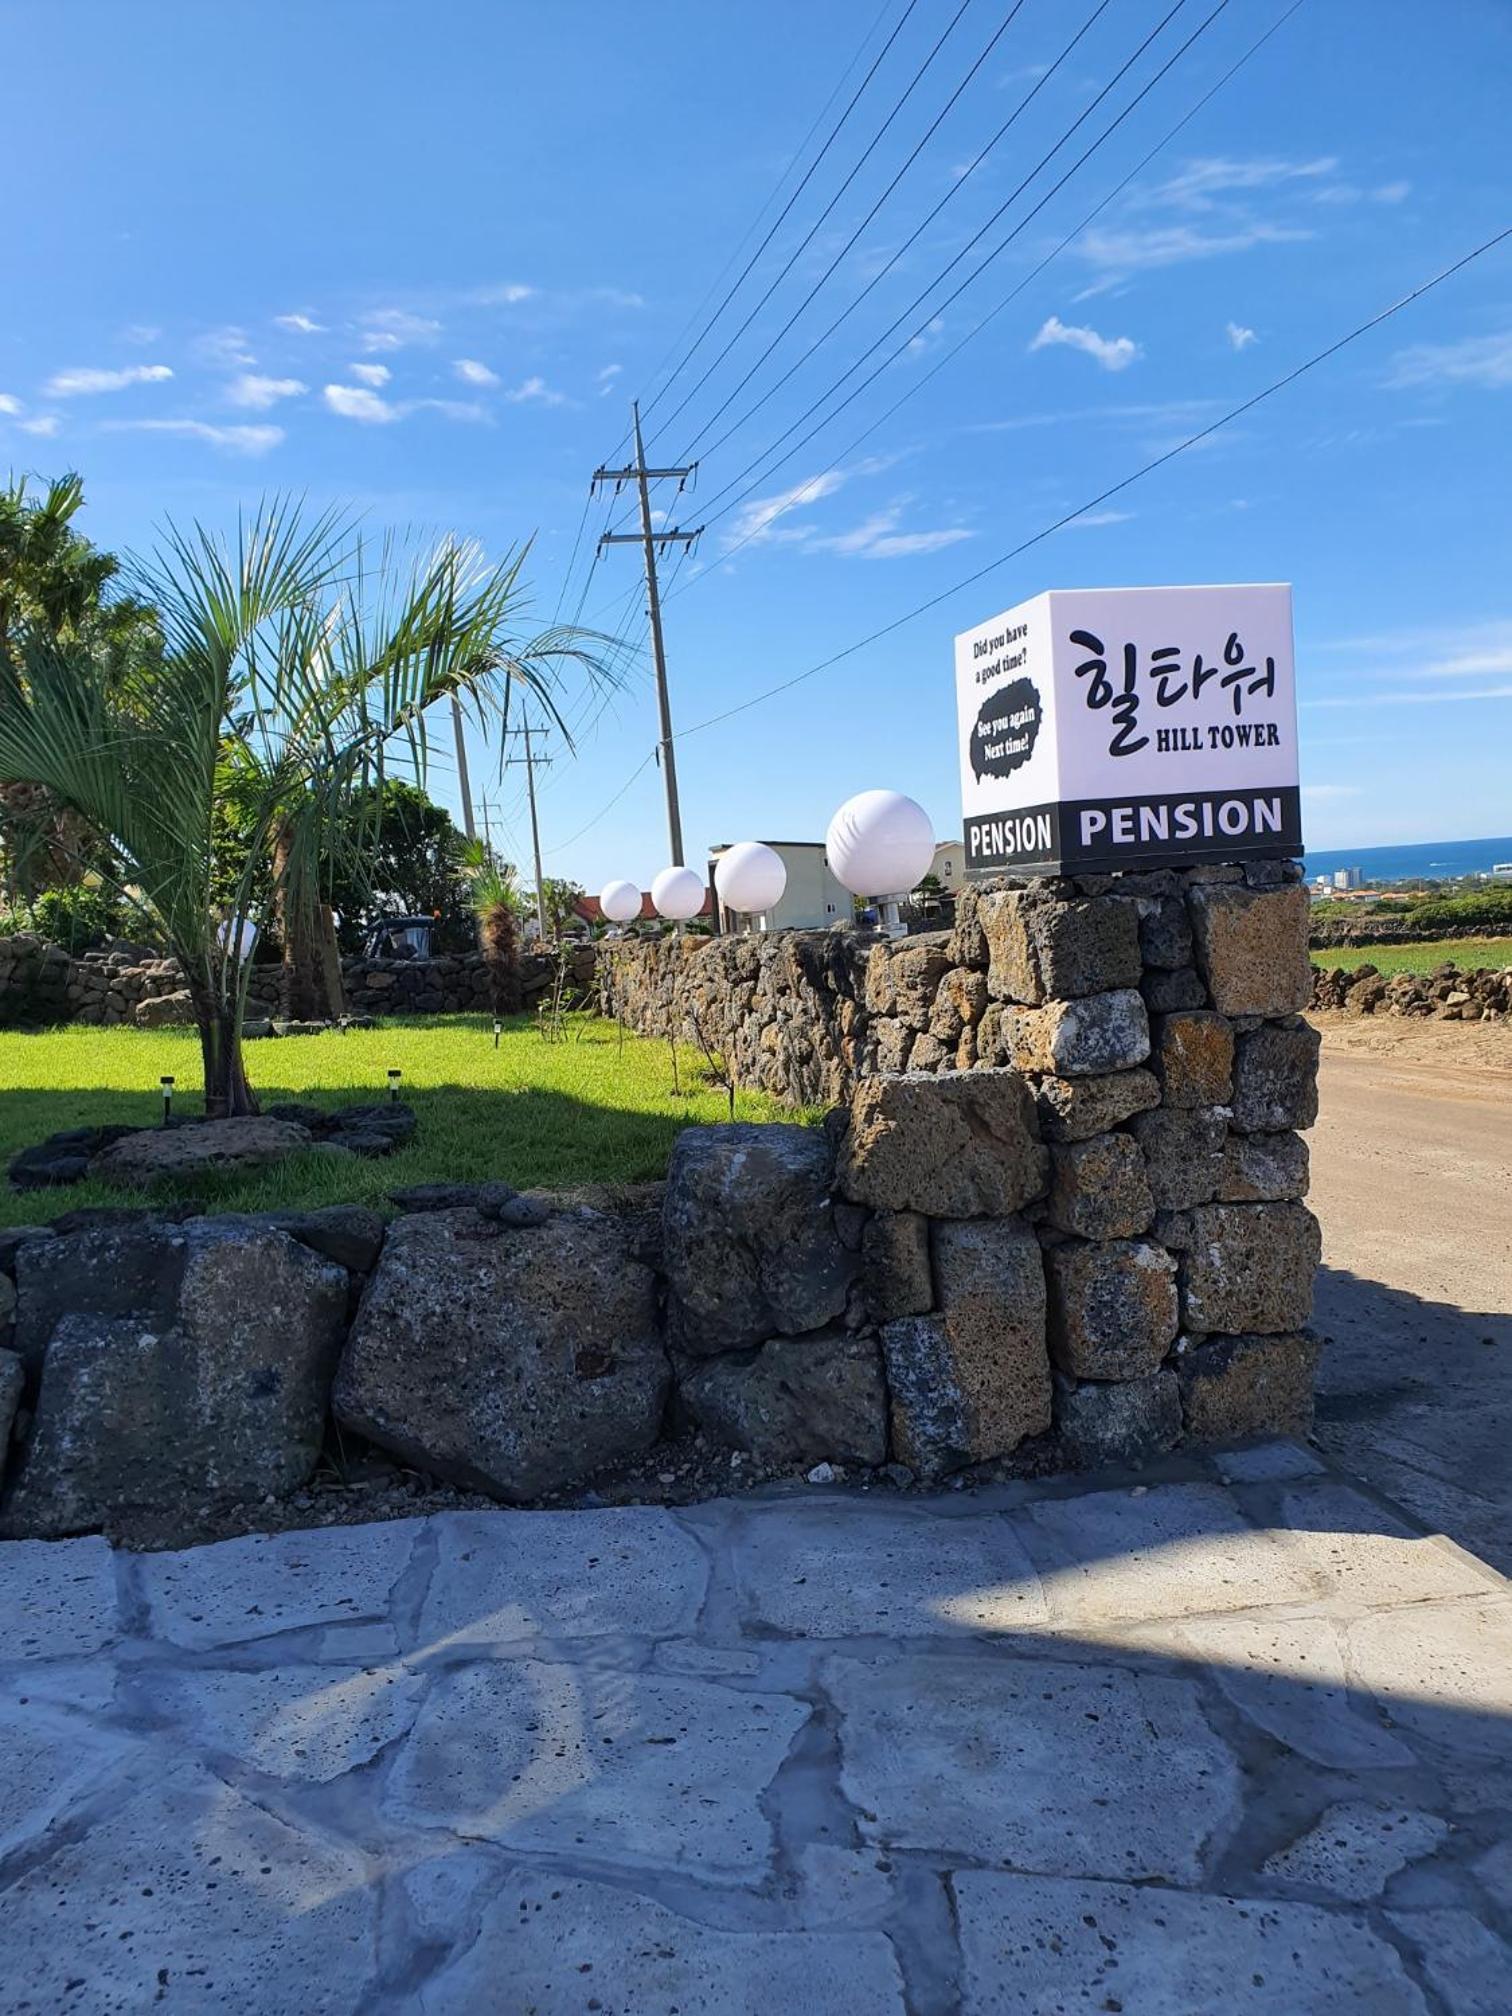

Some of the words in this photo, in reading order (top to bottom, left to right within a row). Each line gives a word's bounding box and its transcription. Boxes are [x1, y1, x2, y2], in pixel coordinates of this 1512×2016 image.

[973, 637, 988, 659] Did
[989, 634, 1005, 655] you
[1006, 623, 1028, 644] have
[975, 671, 981, 684] a
[982, 659, 1001, 685] good
[1002, 647, 1027, 672] time?
[1069, 630, 1275, 757] 힐타워
[977, 720, 992, 738] See
[992, 714, 1009, 737] you
[1009, 705, 1036, 729] again
[1156, 727, 1203, 753] HILL
[1208, 723, 1280, 750] TOWER
[984, 740, 1006, 761] Next
[1005, 733, 1029, 755] time!
[970, 814, 1052, 857] PENSION
[1079, 797, 1283, 846] PENSION
